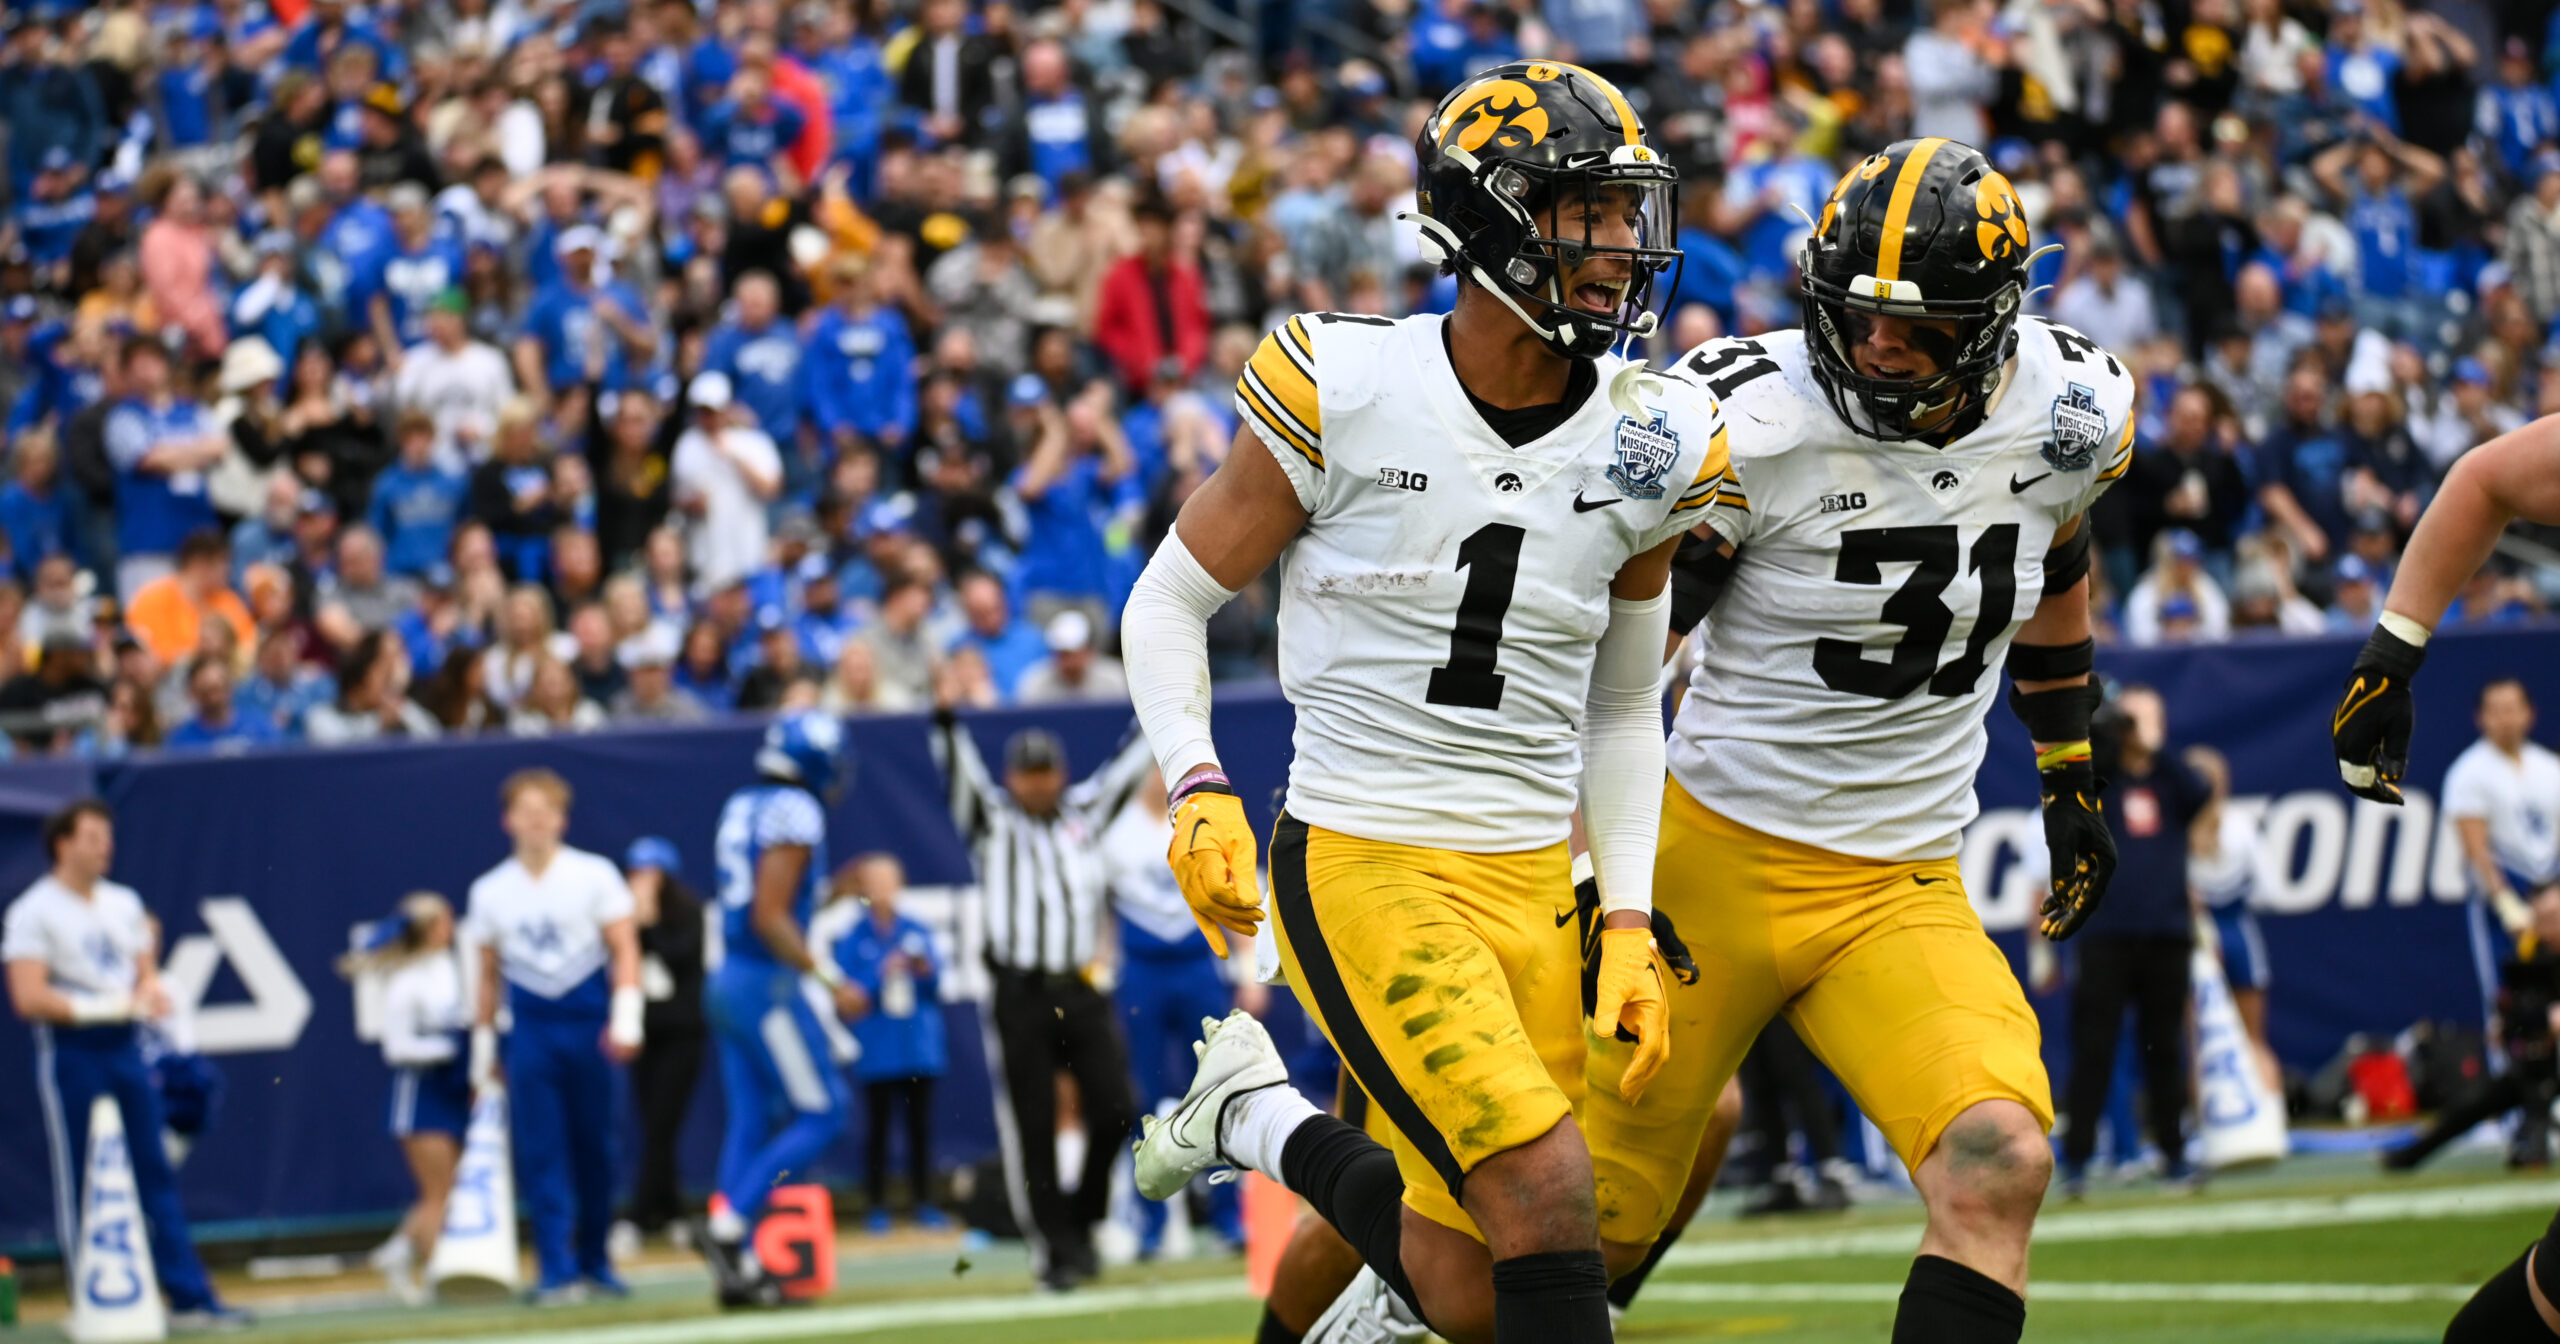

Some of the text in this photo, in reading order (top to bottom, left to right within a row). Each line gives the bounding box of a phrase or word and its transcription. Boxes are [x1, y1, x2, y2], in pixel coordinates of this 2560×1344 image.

[1687, 339, 1783, 402] 31
[1621, 426, 1677, 451] TRANSPERFECT
[2056, 413, 2104, 442] MUSIC CITY
[2063, 429, 2090, 446] BOWL
[1620, 434, 1674, 466] MUSIC CITY
[1629, 450, 1656, 470] BOWL
[1425, 522, 1527, 711] 1
[1812, 523, 2021, 700] 31
